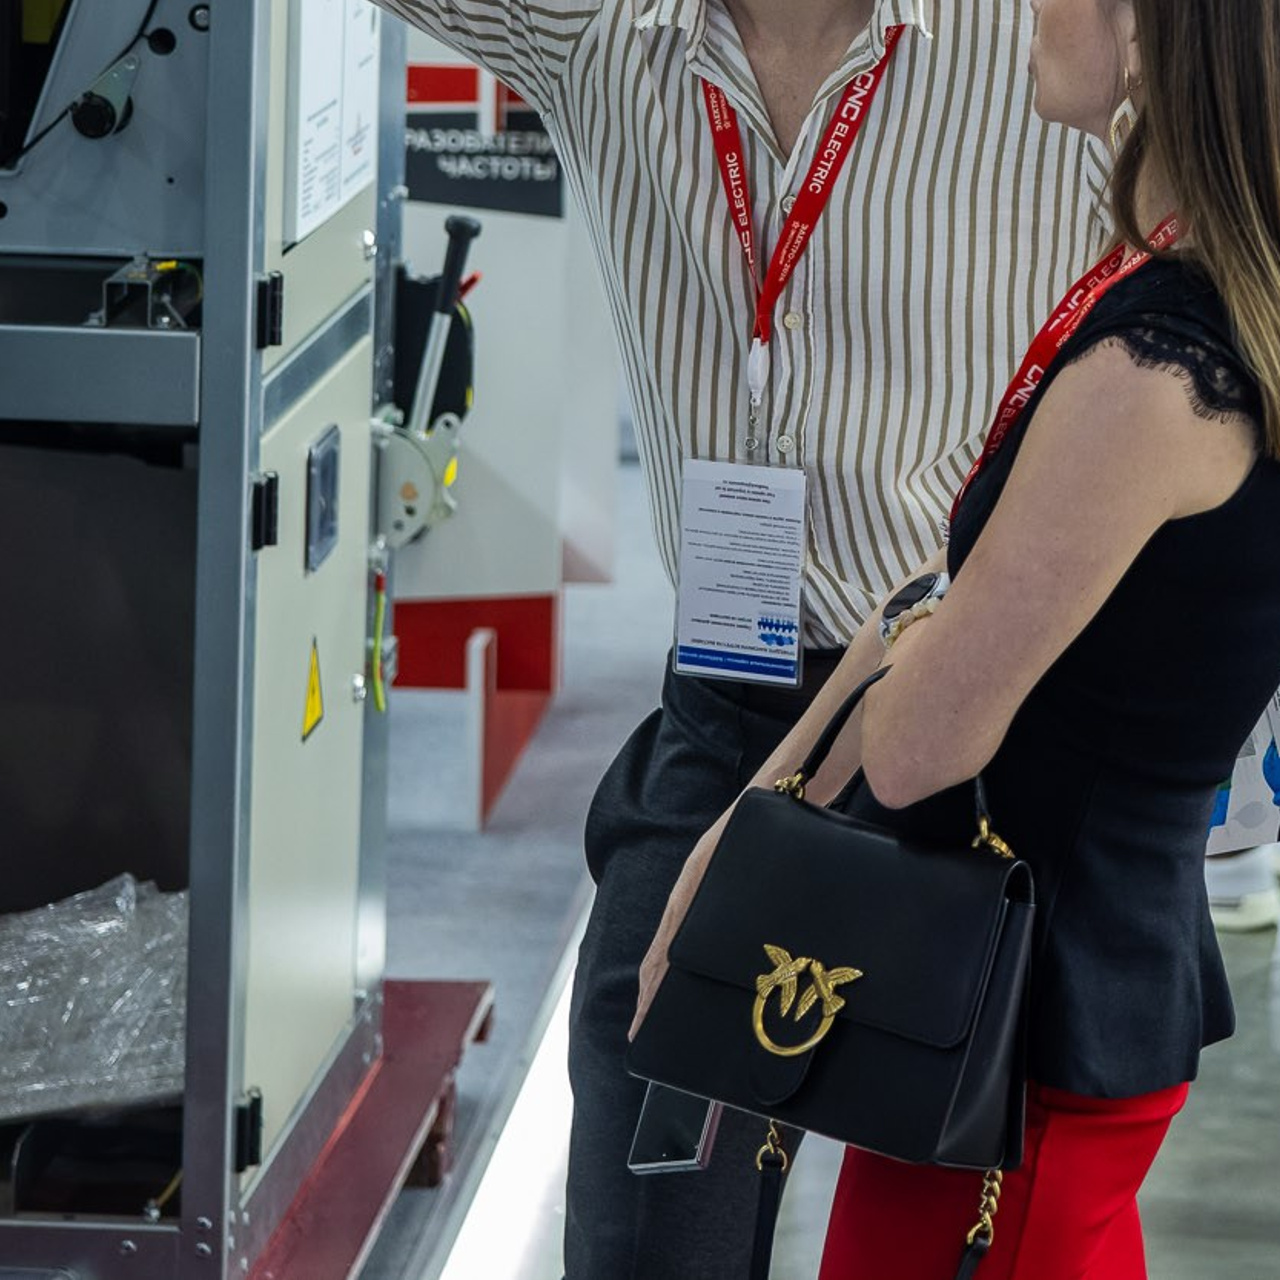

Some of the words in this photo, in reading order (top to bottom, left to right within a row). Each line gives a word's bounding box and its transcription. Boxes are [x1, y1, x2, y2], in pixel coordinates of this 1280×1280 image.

[840, 70, 876, 122] CNC
[437, 154, 557, 181] ЧАСТОТЫ
[808, 122, 850, 195] ELECTRIC
[725, 152, 750, 227] ELECTRIC
[1009, 363, 1045, 409] CNC
